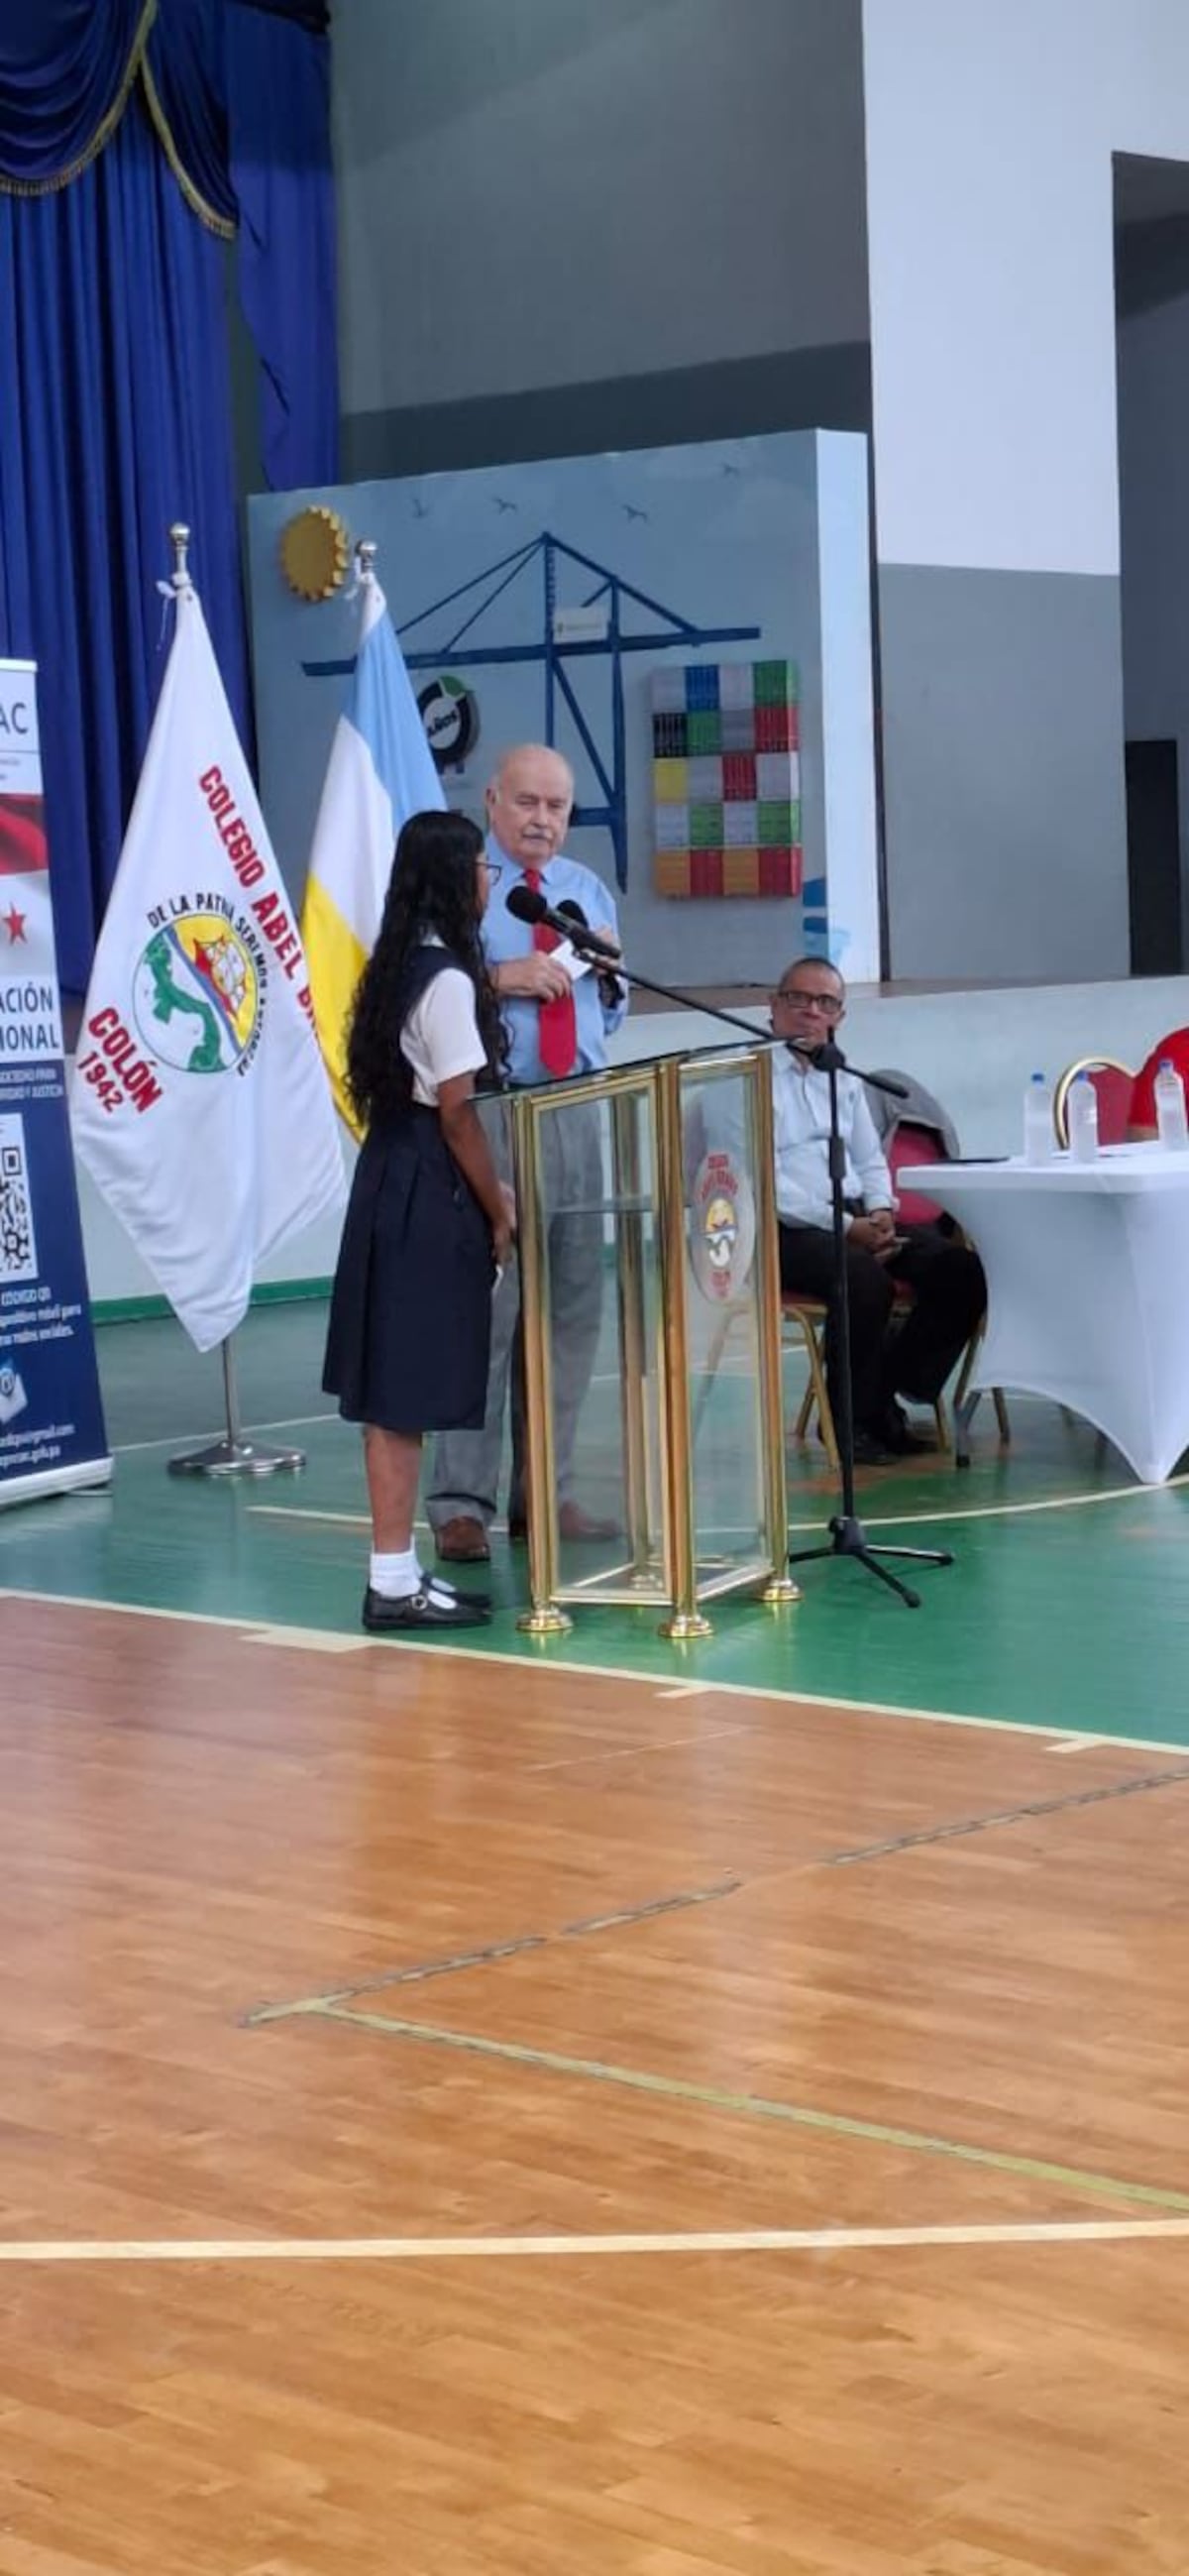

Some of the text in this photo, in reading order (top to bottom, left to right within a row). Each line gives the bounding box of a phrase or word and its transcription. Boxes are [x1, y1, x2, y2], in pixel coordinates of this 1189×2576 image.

[147, 905, 167, 929] DE
[169, 894, 190, 915] LA
[199, 765, 301, 980] COLEGIO ABEL
[77, 1052, 124, 1112] 1942
[88, 1007, 162, 1113] COLÓN
